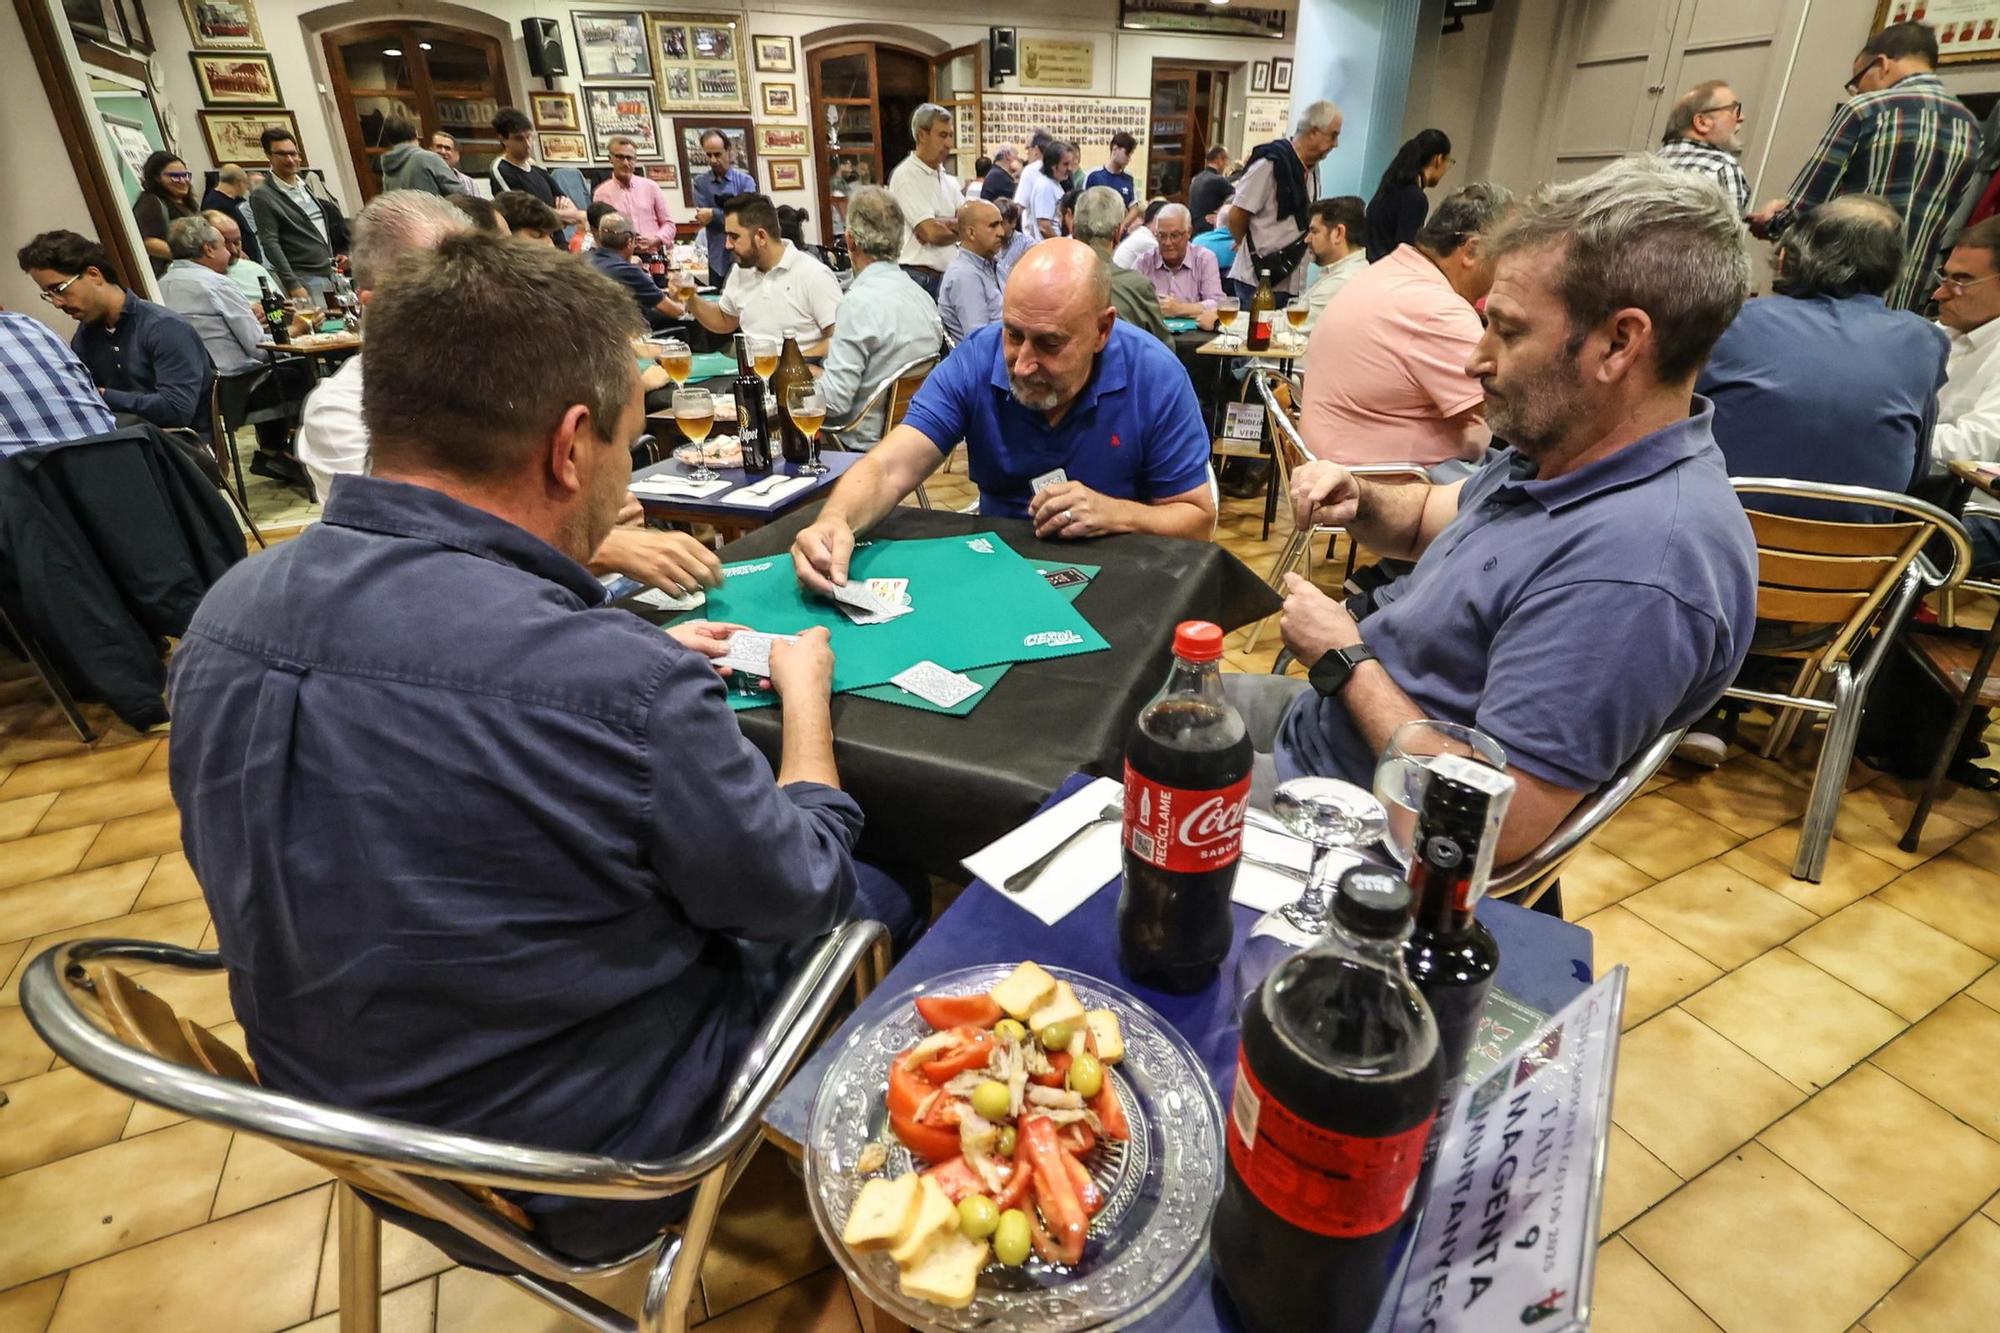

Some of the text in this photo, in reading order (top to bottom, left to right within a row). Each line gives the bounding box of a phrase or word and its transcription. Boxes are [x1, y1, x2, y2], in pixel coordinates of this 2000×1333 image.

[1154, 789, 1173, 867] RECÍCLAME
[1463, 1090, 1532, 1311] MAGENTA
[1514, 1099, 1559, 1250] TAULA 9
